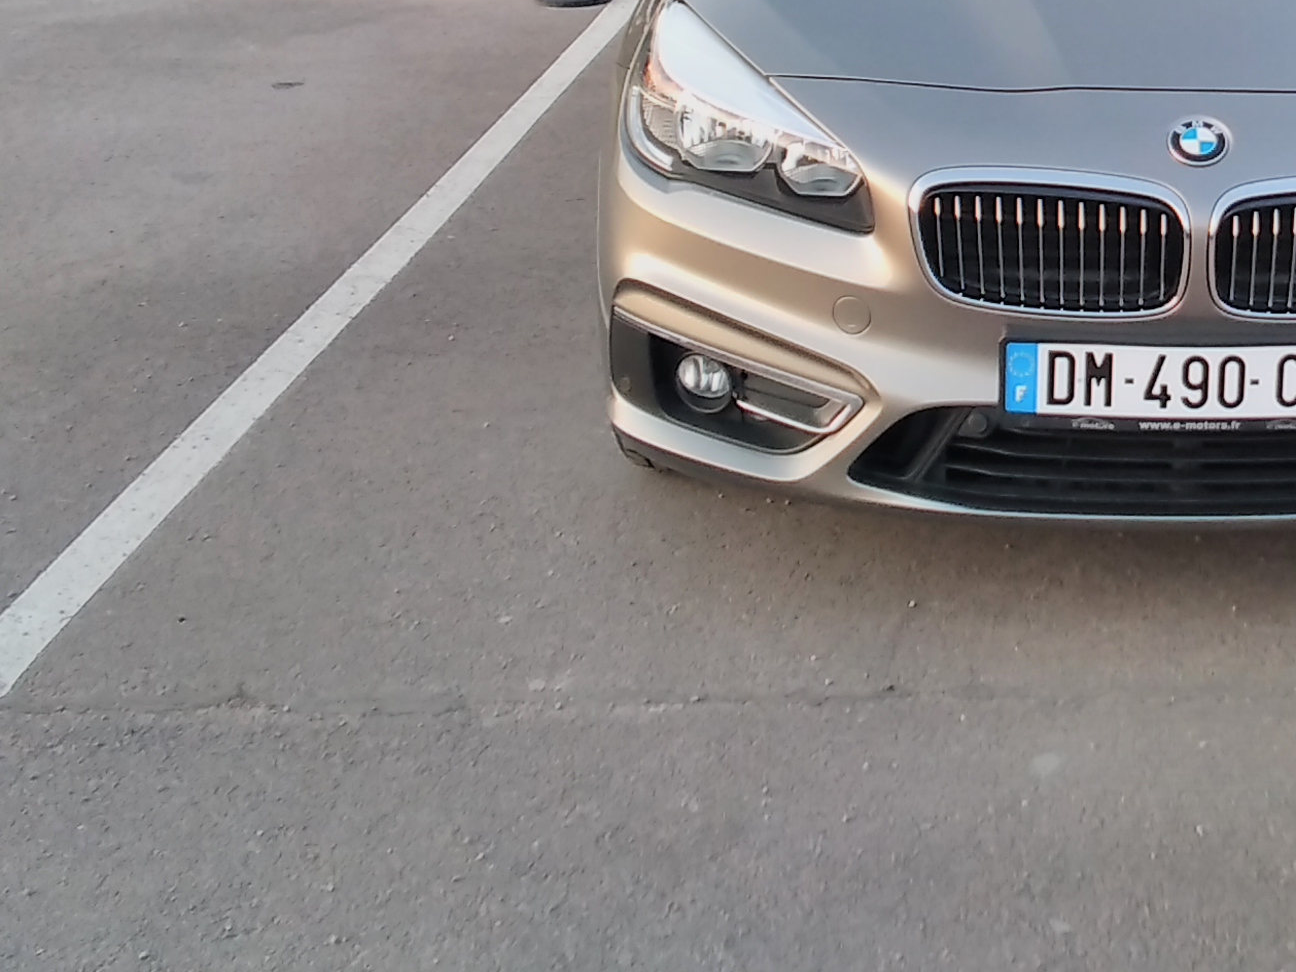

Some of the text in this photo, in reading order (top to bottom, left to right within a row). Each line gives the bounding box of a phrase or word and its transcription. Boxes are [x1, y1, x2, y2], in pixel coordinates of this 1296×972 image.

[1174, 120, 1222, 134] BMW
[1015, 384, 1027, 403] F
[1138, 420, 1241, 431] www.e-motors.fr
